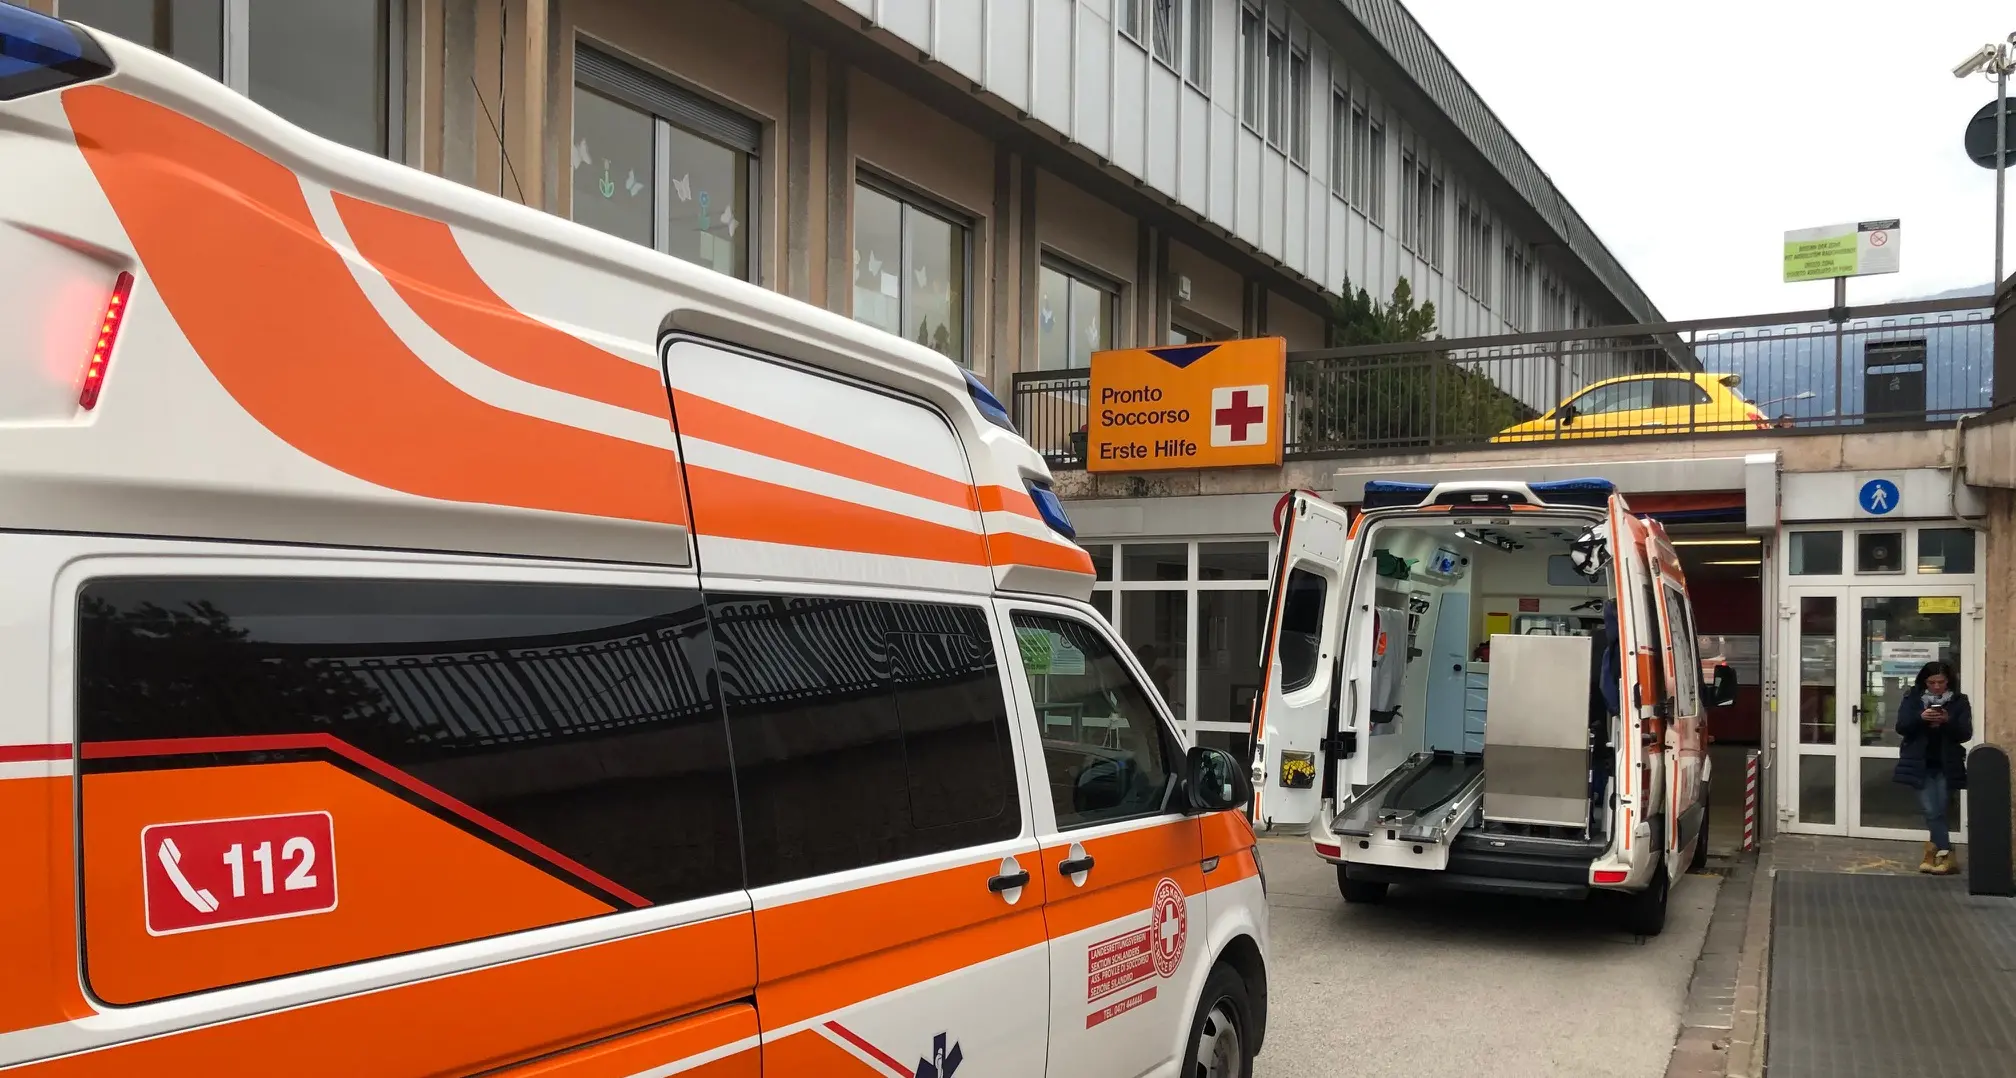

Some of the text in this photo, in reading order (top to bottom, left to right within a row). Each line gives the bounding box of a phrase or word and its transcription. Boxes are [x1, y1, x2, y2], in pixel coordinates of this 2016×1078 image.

[1102, 386, 1162, 404] Pronto
[1101, 409, 1190, 427] Soccorso
[1100, 439, 1197, 459] Erste Hilfe
[223, 836, 317, 898] 112
[1091, 932, 1147, 959] LANDESRETTUNGSVEREIN
[1091, 946, 1141, 972] SEKTION SCHLANDERS
[1126, 955, 1150, 971] SOCCORSO
[1090, 972, 1134, 996] SEZIONE SILANDRO
[1103, 1008, 1113, 1020] TEL.
[1114, 1003, 1126, 1015] 0471
